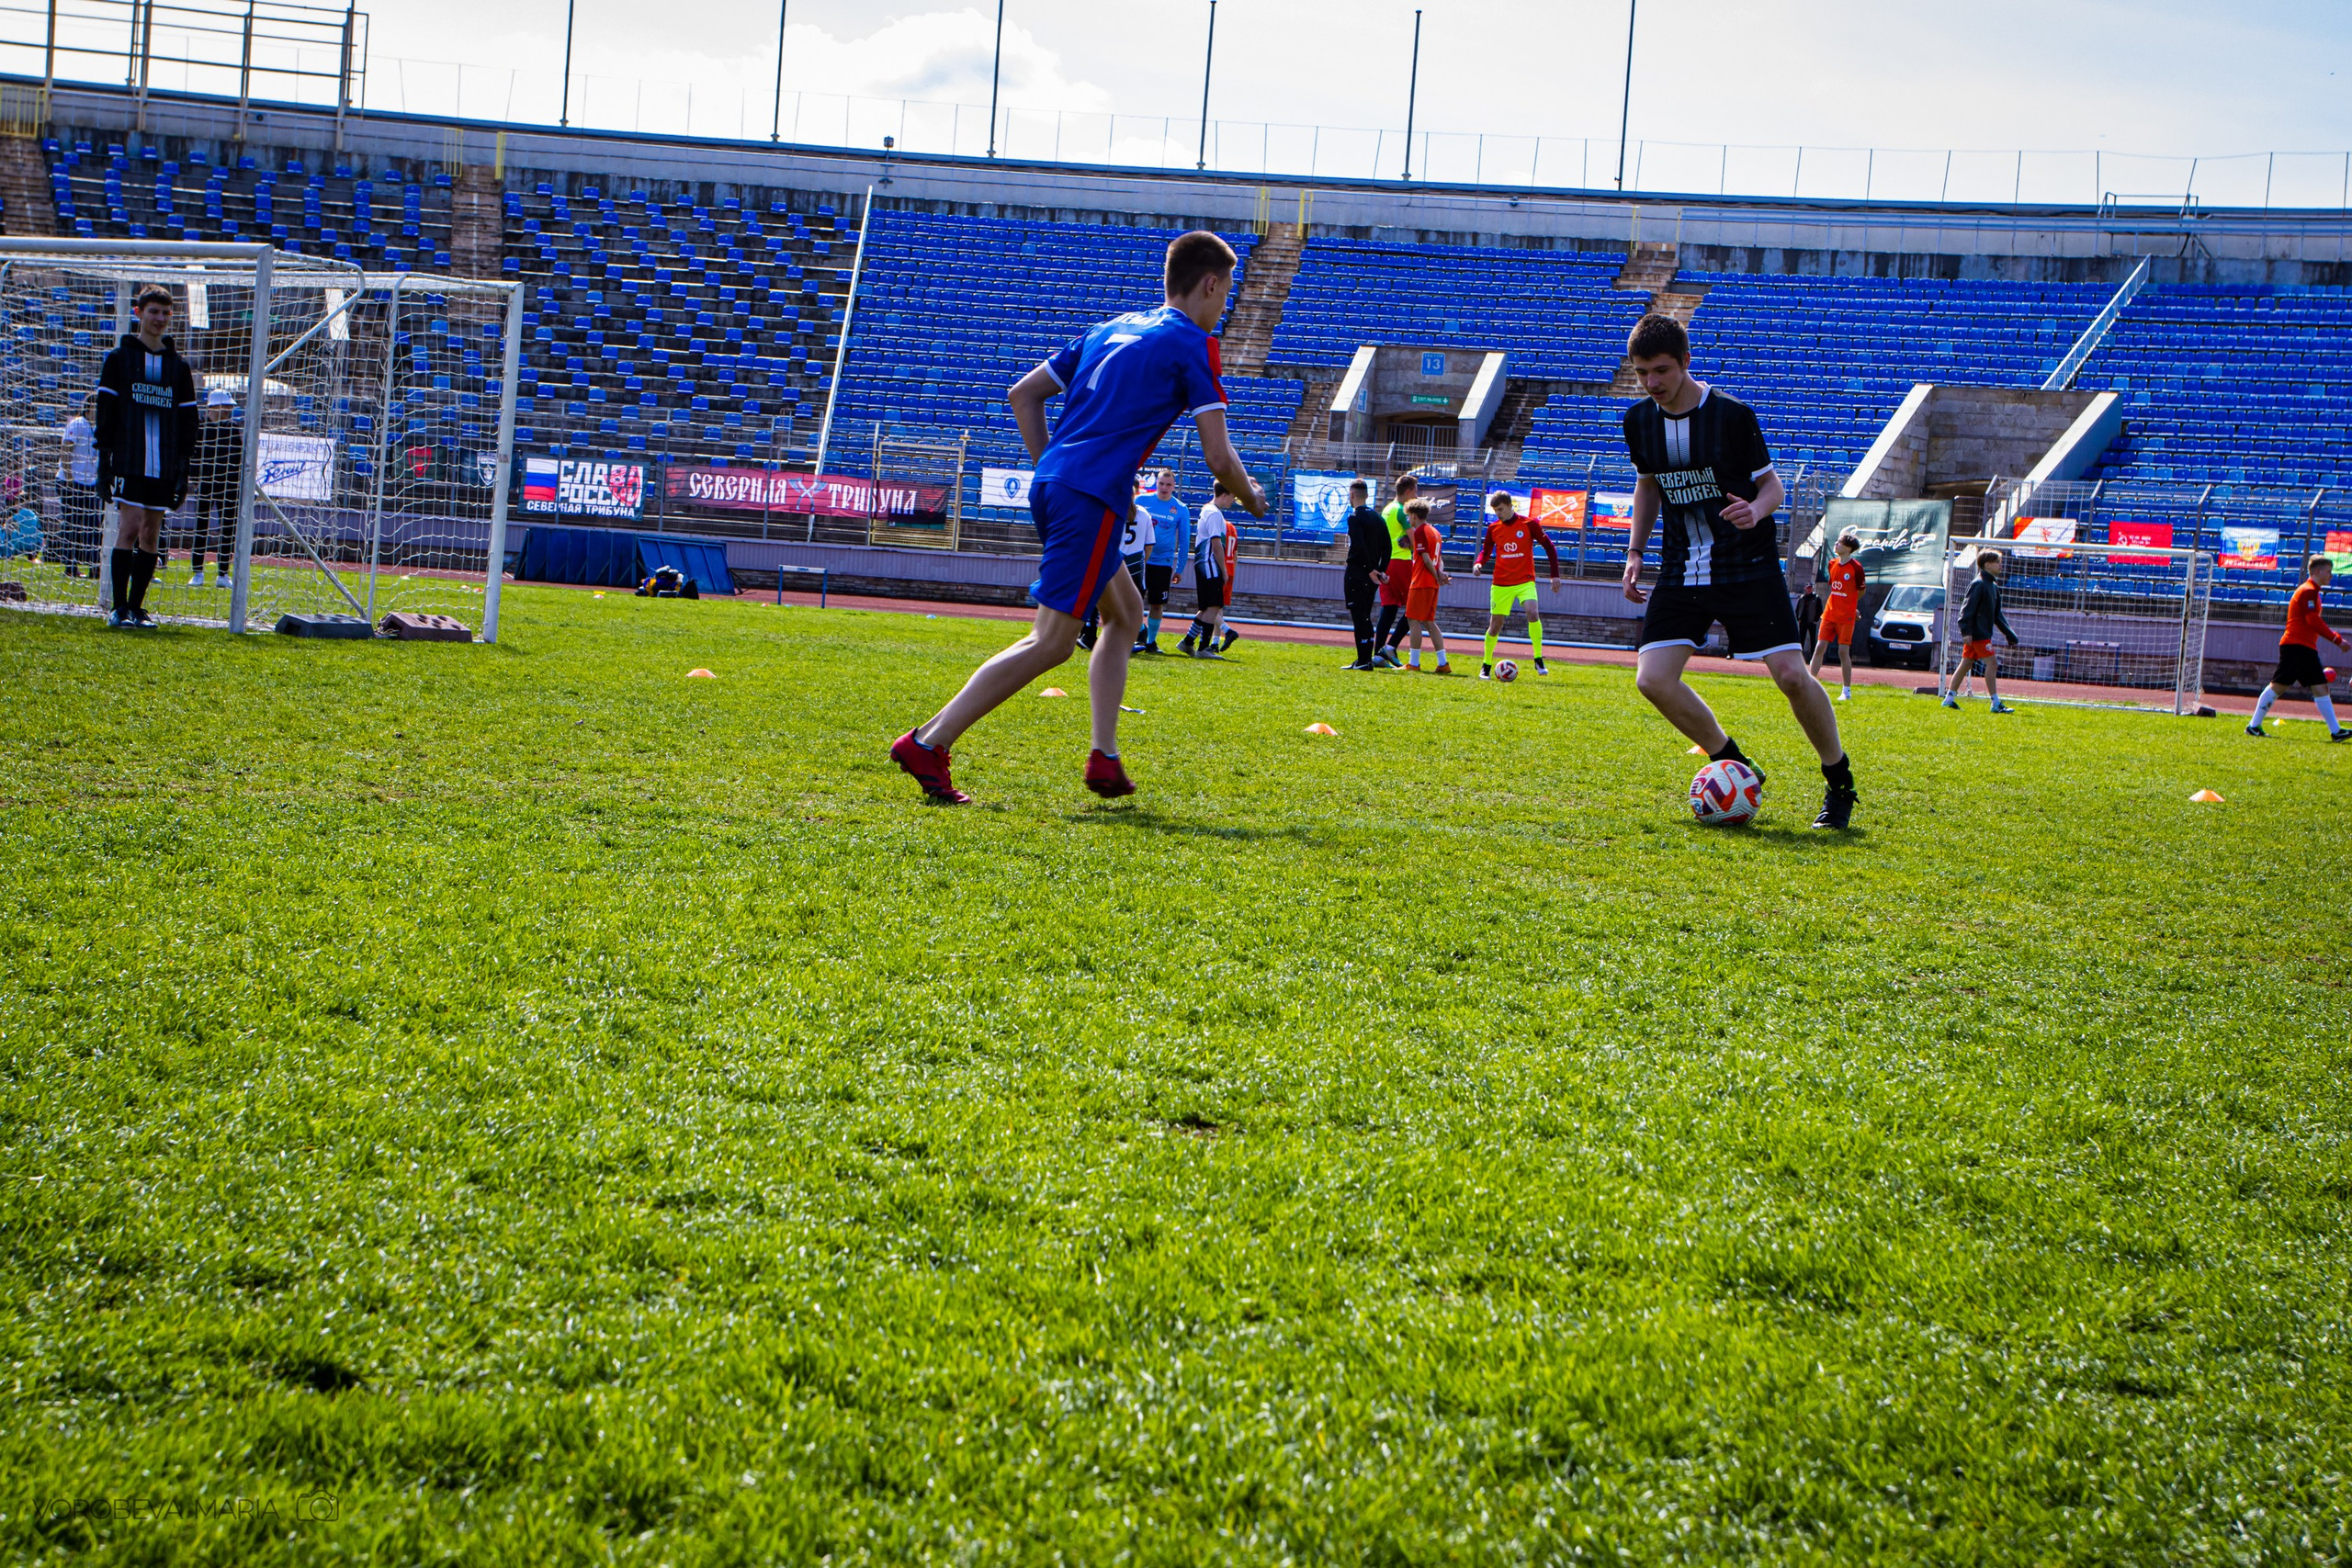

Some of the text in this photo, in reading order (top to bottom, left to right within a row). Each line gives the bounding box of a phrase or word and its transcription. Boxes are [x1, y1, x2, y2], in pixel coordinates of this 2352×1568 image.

[1086, 333, 1143, 390] 7
[1426, 358, 1441, 369] 13
[131, 382, 173, 398] СЕВЕРНЫЙ
[132, 393, 173, 409] ЧЕЛОВЕК
[559, 460, 643, 488] СЛАВА
[559, 482, 642, 508] РОССИИ
[689, 471, 918, 515] СЕВЕРНАЯ ТРИБУНА
[1663, 483, 1723, 504] ЕЛОВЕК
[585, 504, 635, 517] ТРИБУНА
[1125, 521, 1137, 545] 5
[1433, 541, 1441, 566] 9
